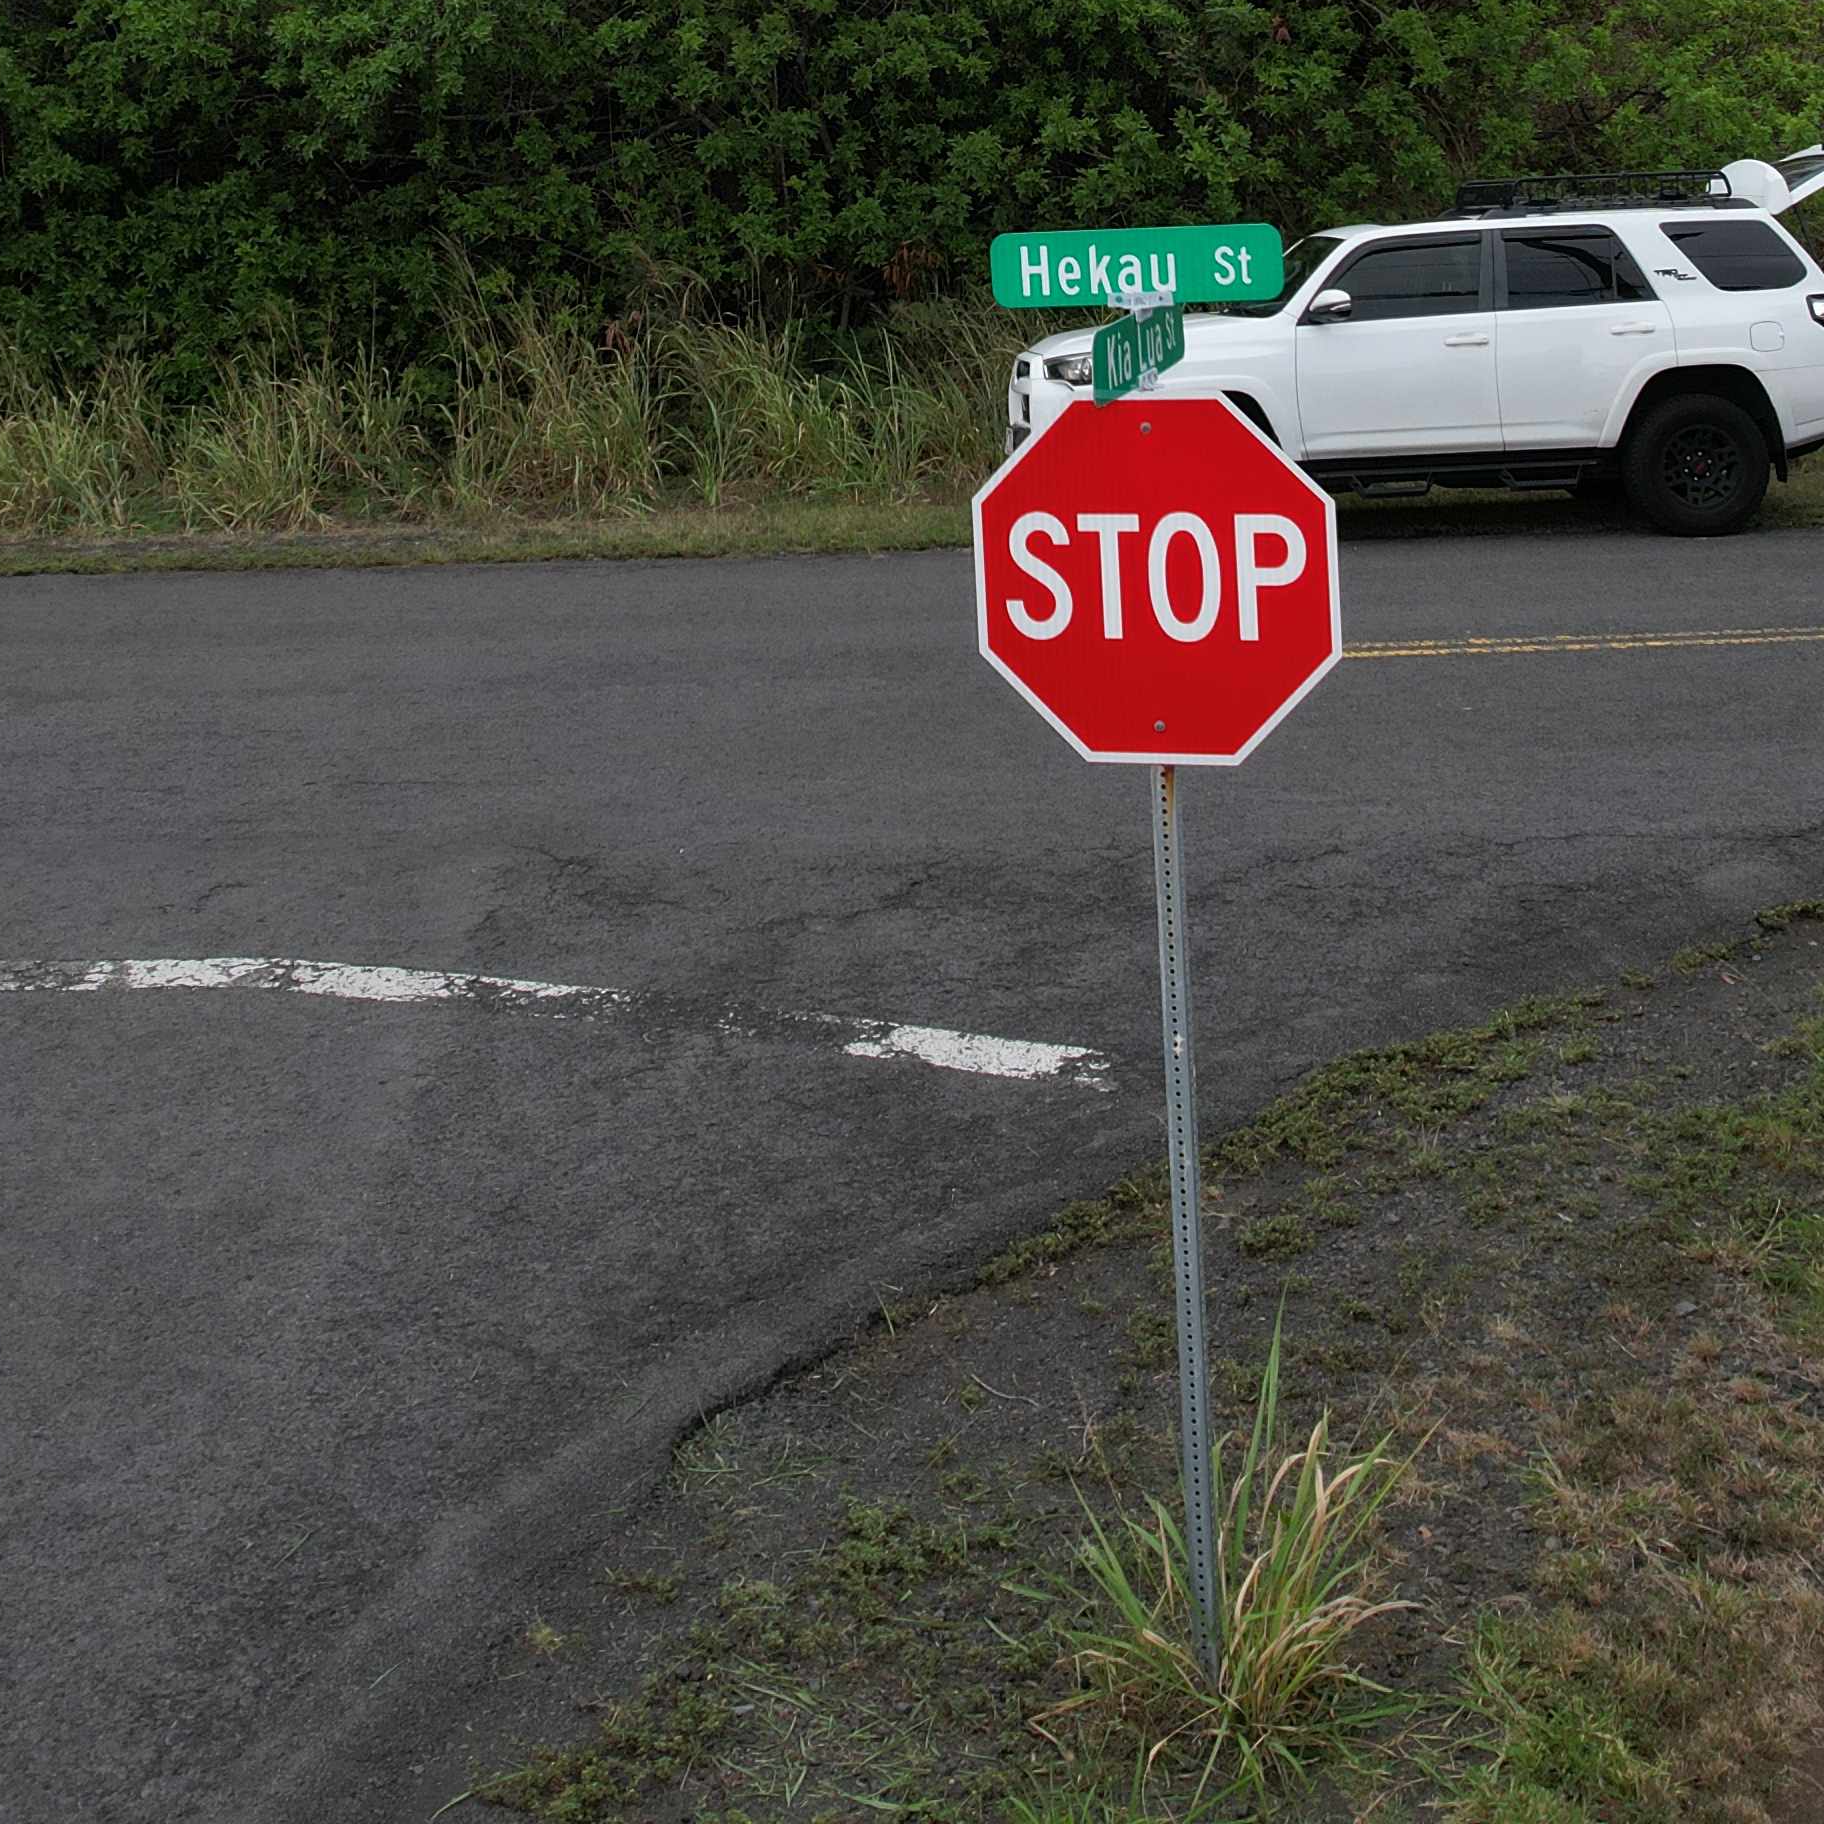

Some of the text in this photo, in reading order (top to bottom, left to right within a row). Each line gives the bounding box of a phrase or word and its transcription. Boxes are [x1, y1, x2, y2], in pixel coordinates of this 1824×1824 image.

[1019, 244, 1253, 297] Hekau St
[1107, 310, 1177, 392] Kia Lua St
[1005, 510, 1308, 643] STOP
